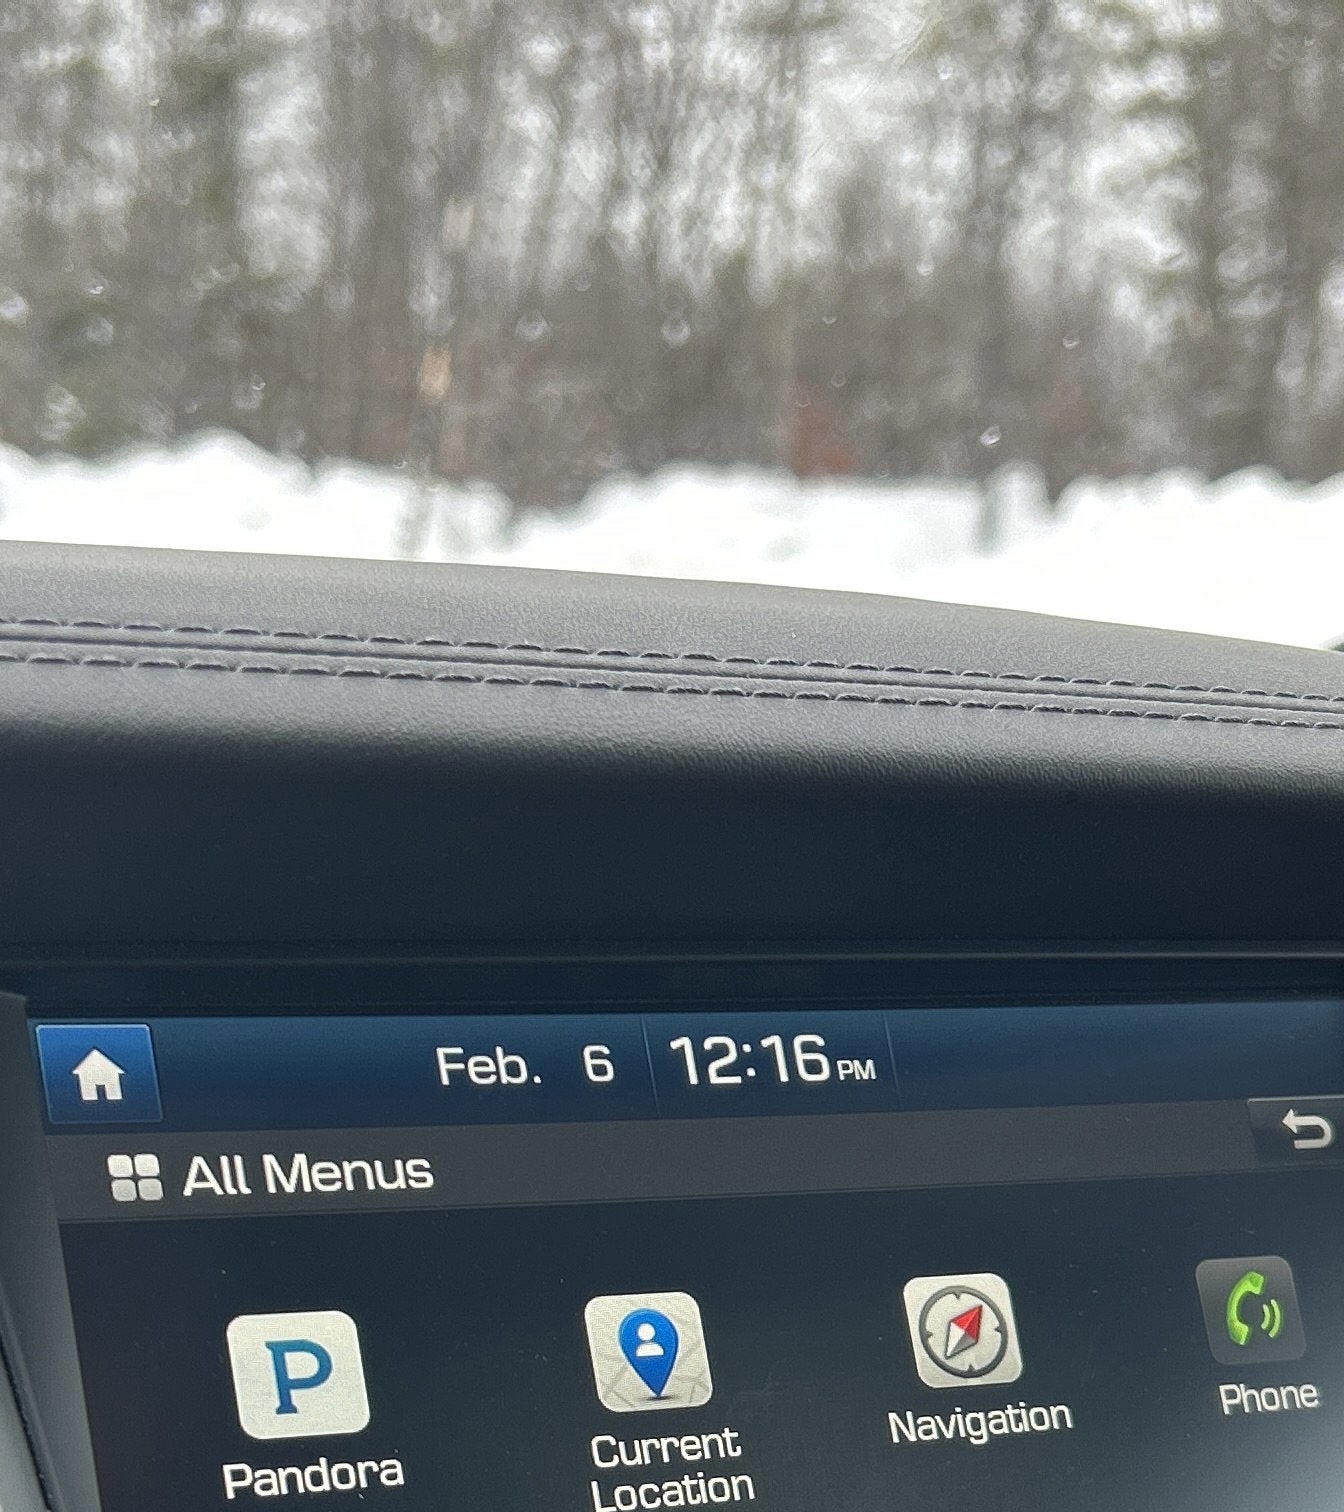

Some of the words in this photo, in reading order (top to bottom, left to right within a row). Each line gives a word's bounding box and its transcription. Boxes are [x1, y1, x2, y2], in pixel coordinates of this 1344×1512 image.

[435, 1046, 543, 1088] Feb.
[583, 1044, 615, 1084] 6
[670, 1033, 830, 1086] 12:16
[837, 1058, 876, 1081] PM
[182, 1154, 252, 1197] All
[262, 1151, 435, 1194] Menus
[265, 1338, 334, 1415] P
[1218, 1380, 1321, 1416] Phone
[887, 1400, 1074, 1446] Navigation
[590, 1426, 743, 1470] Current
[221, 1455, 405, 1501] Pandora
